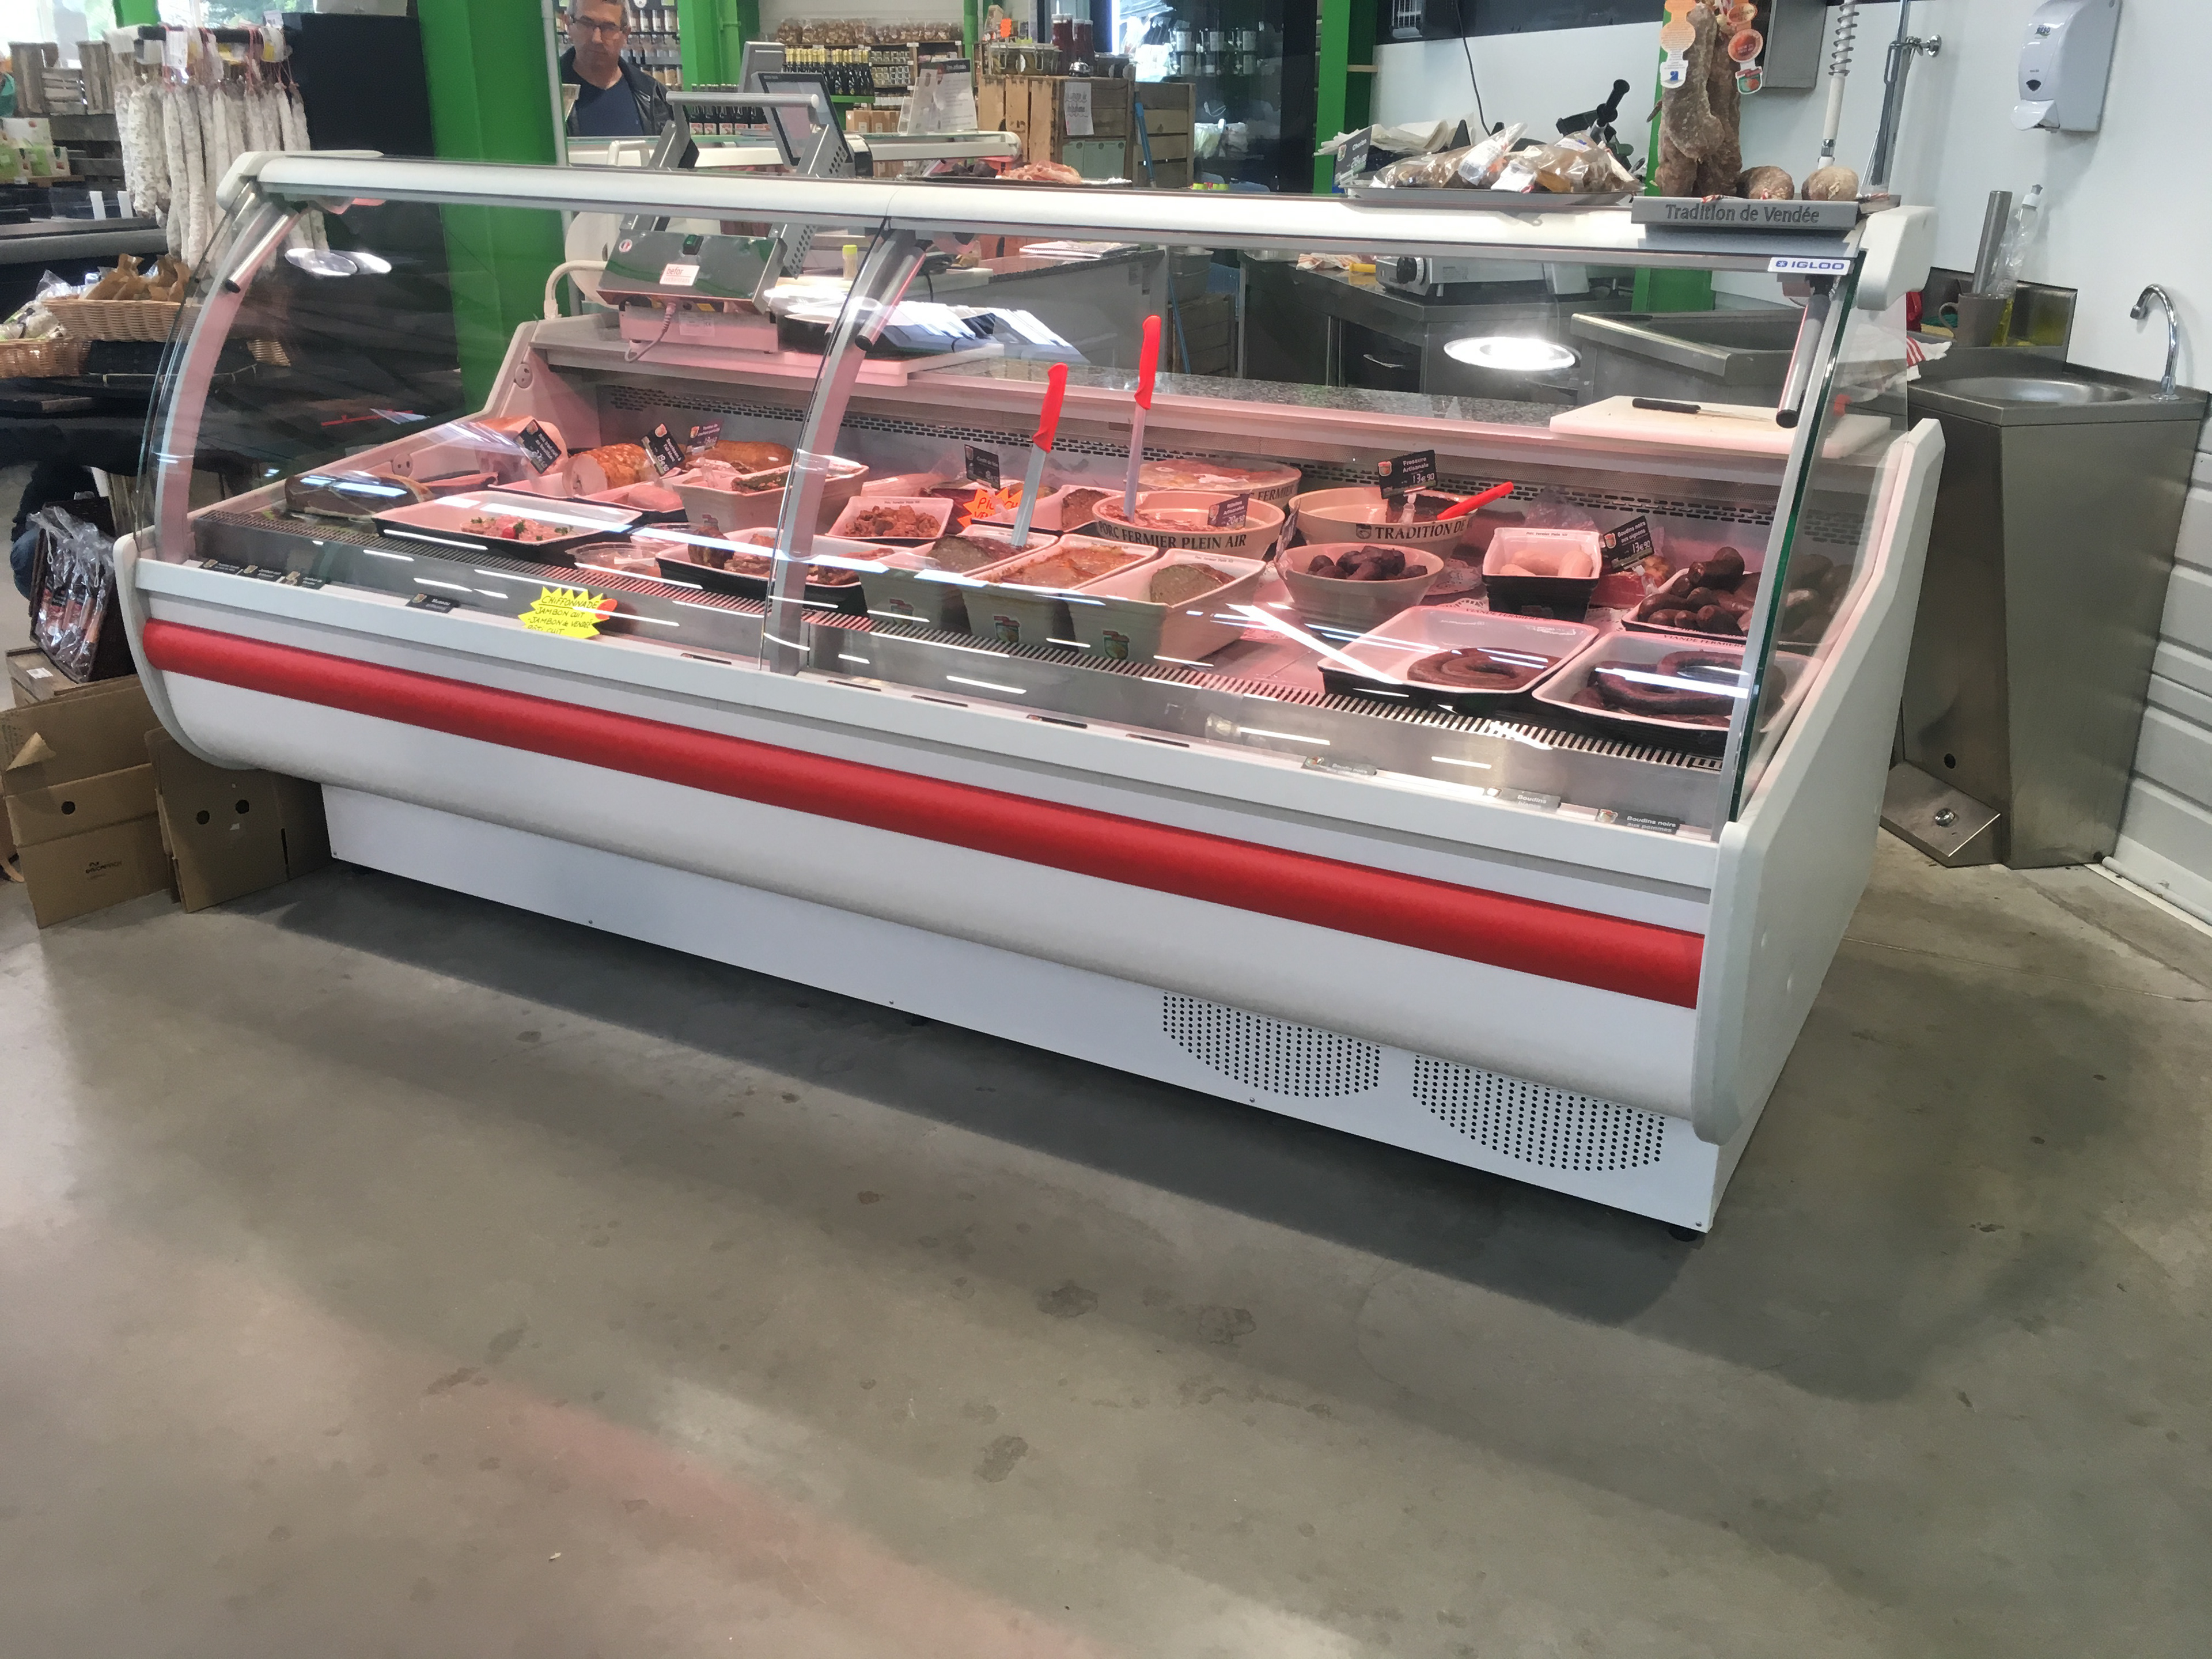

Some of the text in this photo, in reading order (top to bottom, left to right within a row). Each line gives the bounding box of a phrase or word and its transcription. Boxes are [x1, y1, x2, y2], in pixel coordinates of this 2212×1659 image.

[1665, 203, 1820, 224] Tradition de Vendée
[1791, 260, 1845, 270] IGLOO
[666, 266, 684, 275] befor
[1403, 456, 1427, 466] Fressure
[1402, 463, 1429, 473] Artisanale
[1375, 521, 1452, 539] TRADITION
[1453, 520, 1465, 532] DE
[1618, 521, 1646, 537] Boudins noirs
[1099, 521, 1119, 539] PORC
[1122, 529, 1176, 548] FERMIER
[1181, 536, 1222, 550] PLEIN
[1225, 534, 1247, 548] AIR
[1629, 529, 1646, 541] oignons
[1664, 634, 1698, 642] VIANDE
[1517, 794, 1547, 804] Boudins
[1627, 816, 1677, 828] Boudins noirs
[1641, 824, 1672, 832] pommes
